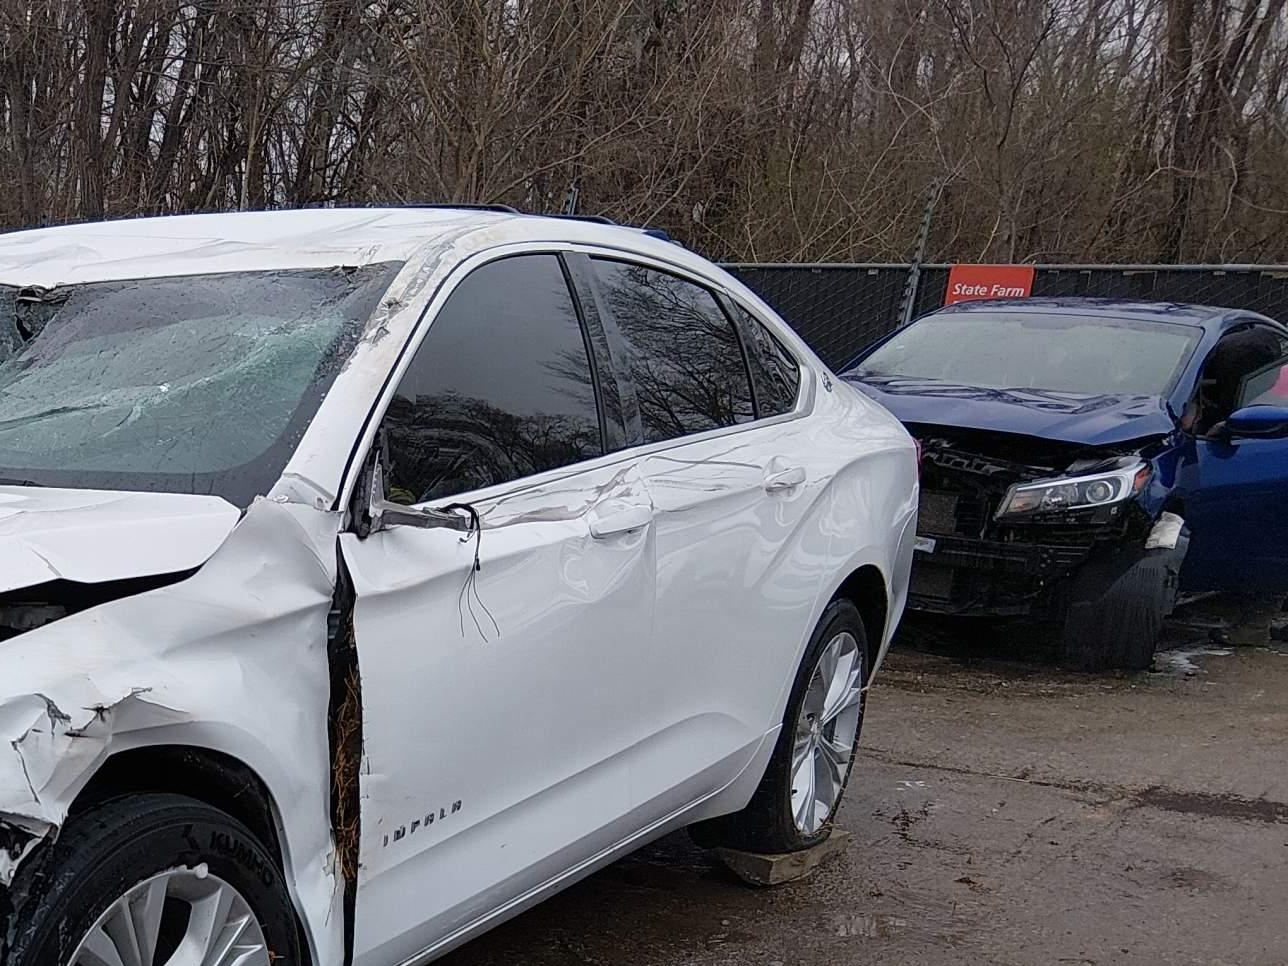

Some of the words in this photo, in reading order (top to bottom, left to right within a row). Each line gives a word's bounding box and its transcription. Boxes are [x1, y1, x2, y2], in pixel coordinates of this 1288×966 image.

[952, 283, 987, 296] State
[991, 284, 1024, 297] Farm
[383, 799, 462, 848] IMPALA
